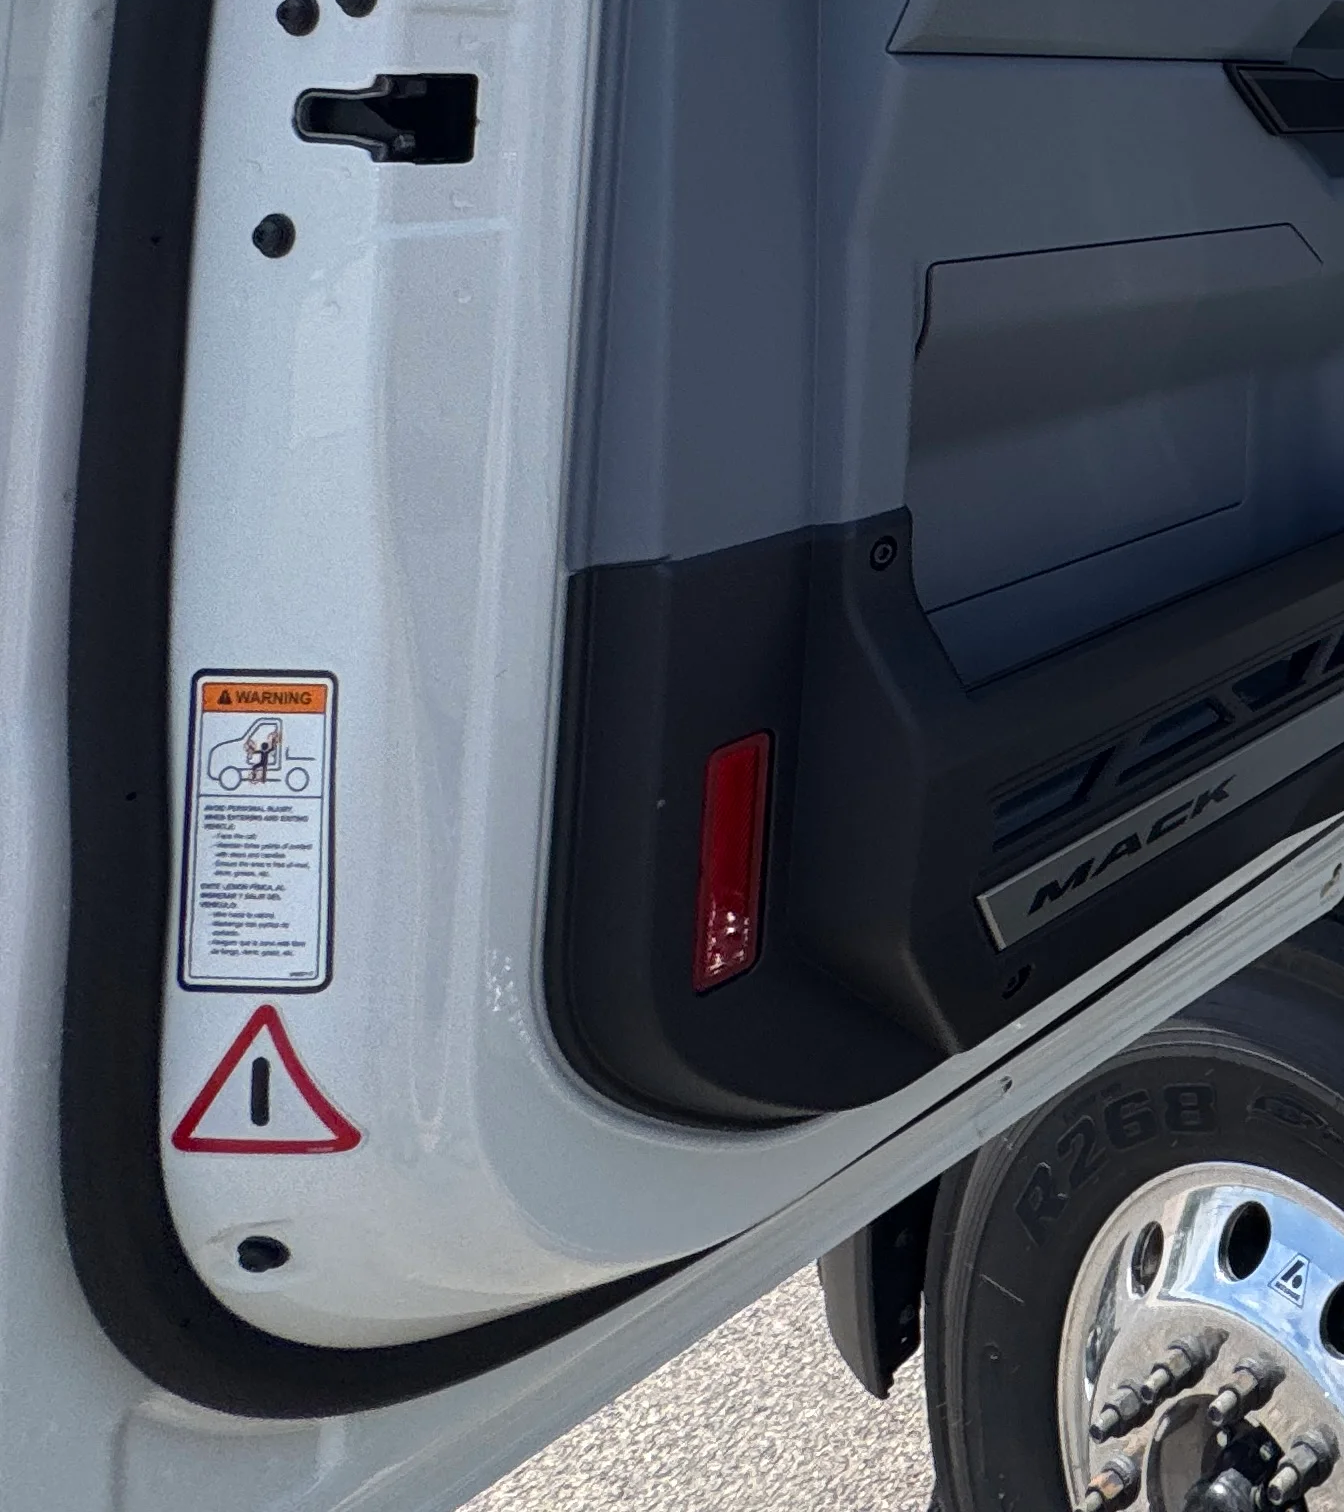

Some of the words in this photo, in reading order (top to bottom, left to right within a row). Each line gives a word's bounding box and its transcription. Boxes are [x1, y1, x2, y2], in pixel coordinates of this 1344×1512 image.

[235, 689, 313, 707] WARNING
[1027, 772, 1236, 915] MACK
[1013, 1080, 1218, 1247] R268
